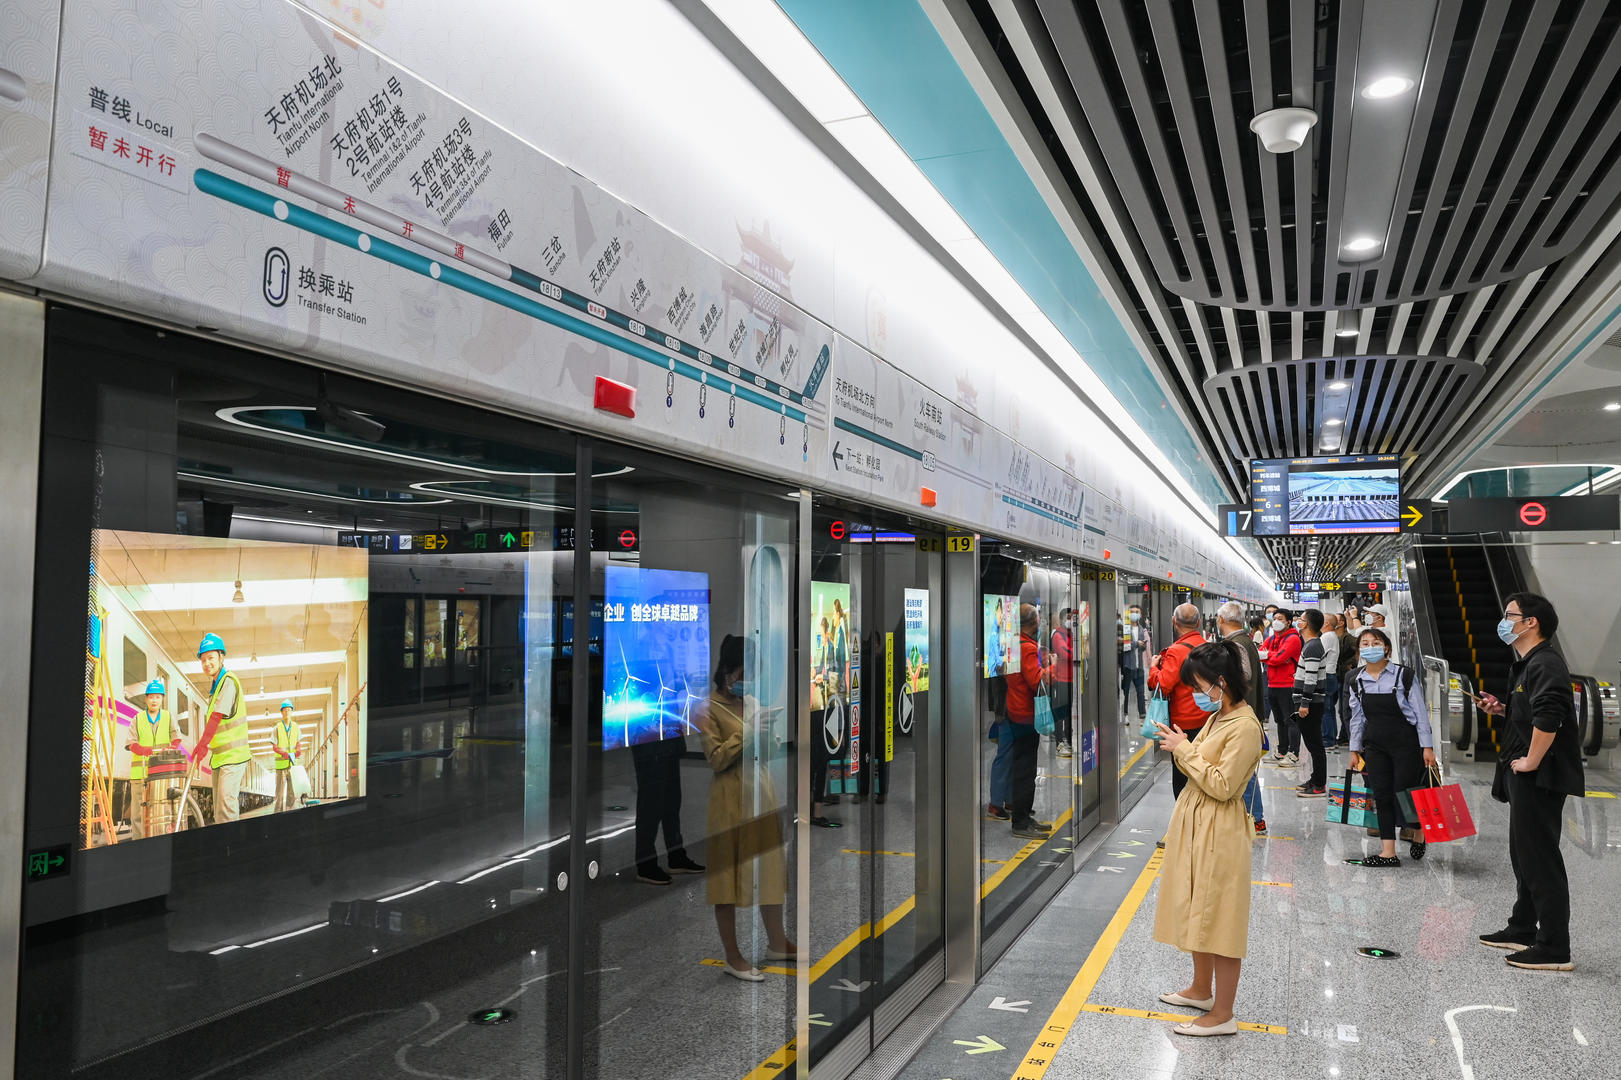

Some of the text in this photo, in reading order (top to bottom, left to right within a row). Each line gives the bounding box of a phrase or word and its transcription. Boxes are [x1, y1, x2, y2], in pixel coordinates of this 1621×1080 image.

[88, 86, 132, 123] 普线
[264, 54, 342, 134] 天府机场北
[277, 78, 344, 146] Tianfu International
[136, 112, 174, 138] Local
[285, 111, 330, 158] Airport North
[330, 76, 402, 160] 天府机场1号
[346, 105, 408, 176] 2号航站楼
[88, 126, 176, 176] 暂未开行
[360, 112, 426, 184] Terminal 1&2 of Tianfu
[367, 129, 426, 194] International Airport
[410, 117, 472, 196] 天府机场3号
[425, 144, 476, 208] 4号航站楼
[436, 186, 461, 217] Terminal
[459, 176, 471, 190] 3&4
[475, 149, 492, 170] Tianfu
[442, 166, 492, 226] International Airport
[276, 166, 464, 260] 暂未开通
[488, 209, 511, 242] 福田
[542, 236, 562, 267] 三岔
[550, 252, 566, 276] Sancha
[589, 237, 621, 288] 天府新站
[298, 264, 354, 304] 换乘站
[630, 278, 646, 308] 兴隆
[297, 294, 367, 325] Transfer Station
[836, 378, 875, 408] 天府机场北方向
[920, 397, 942, 424] 火车南站
[951, 537, 970, 551] 19
[1101, 572, 1114, 581] 20
[604, 603, 698, 622] 企业 创全球卓越品牌
